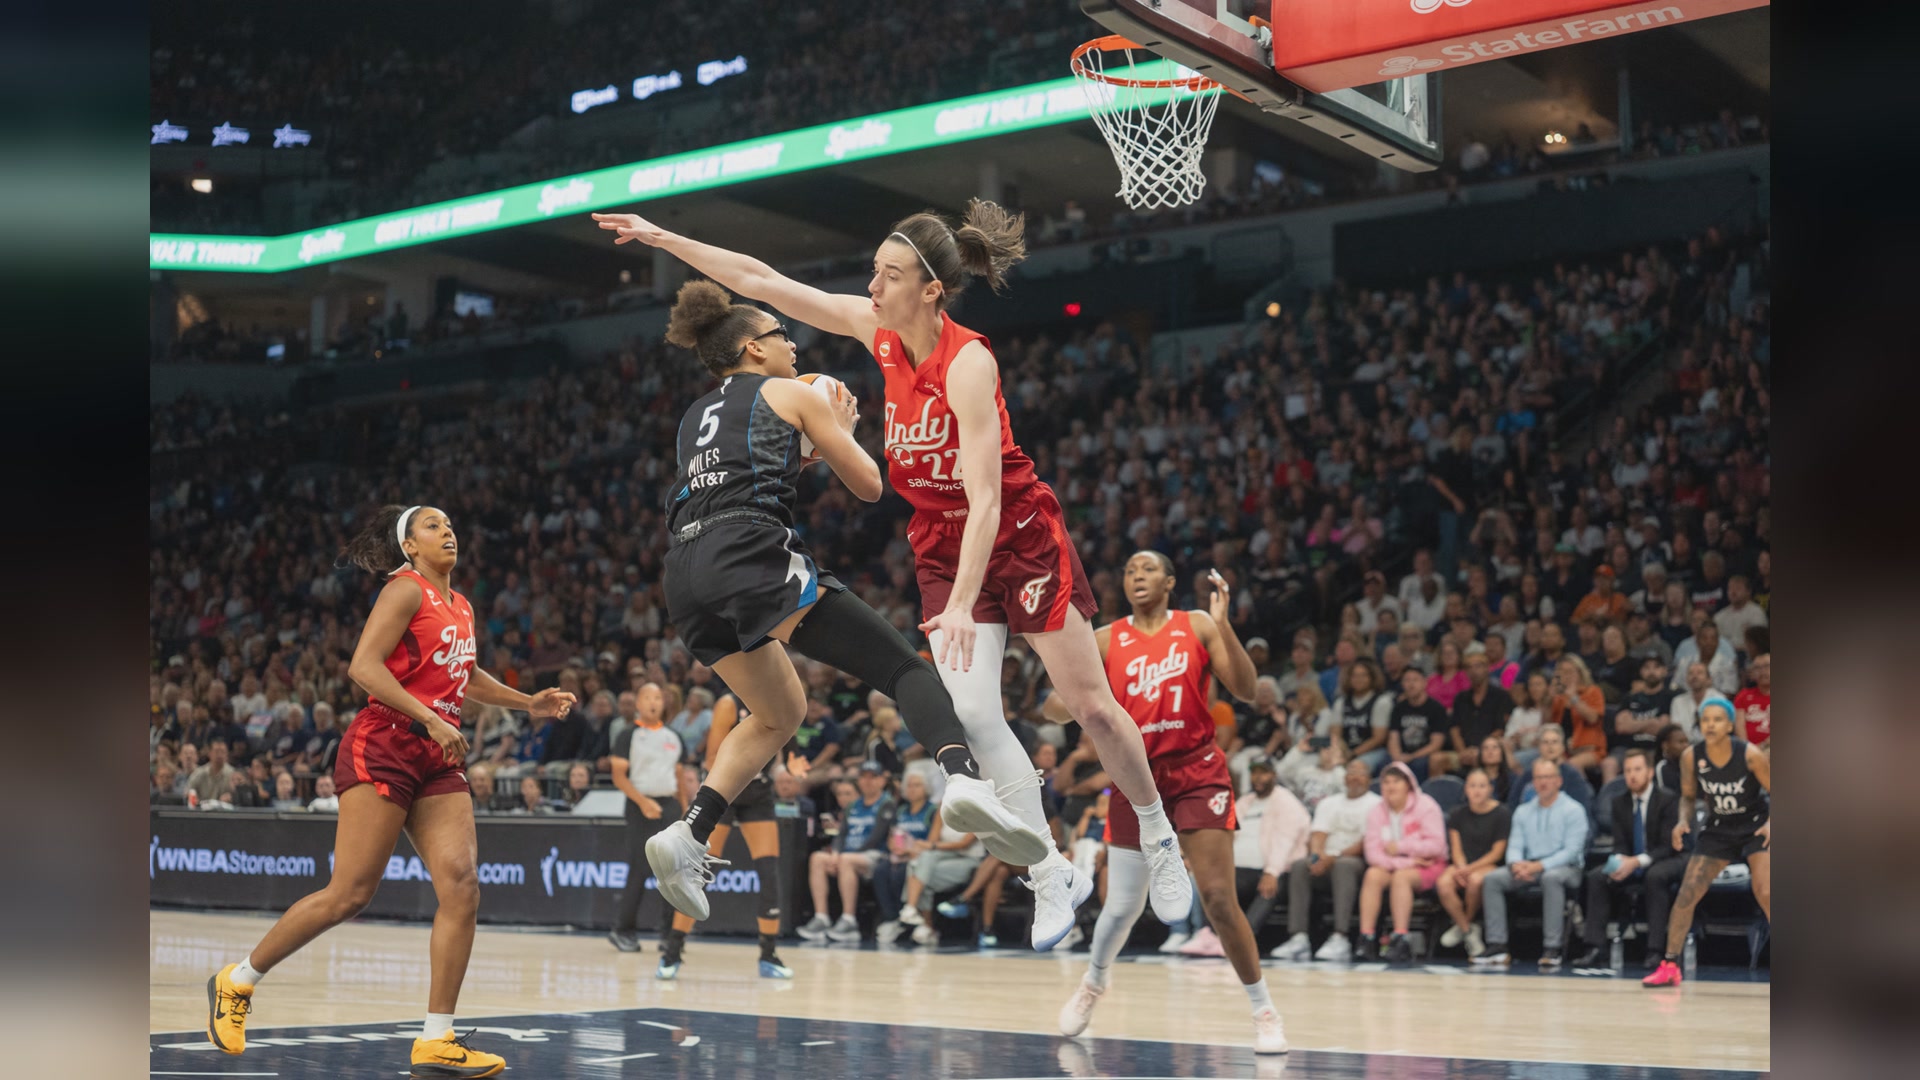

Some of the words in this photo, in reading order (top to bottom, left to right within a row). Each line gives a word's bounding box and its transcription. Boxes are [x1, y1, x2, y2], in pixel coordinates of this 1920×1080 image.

[695, 400, 726, 447] 5
[690, 470, 728, 492] AT&T
[1125, 642, 1189, 697] Indy
[1169, 685, 1183, 713] 7
[1700, 776, 1747, 795] LYNX
[1714, 795, 1738, 810] 10
[157, 848, 315, 877] WNBAStore.com
